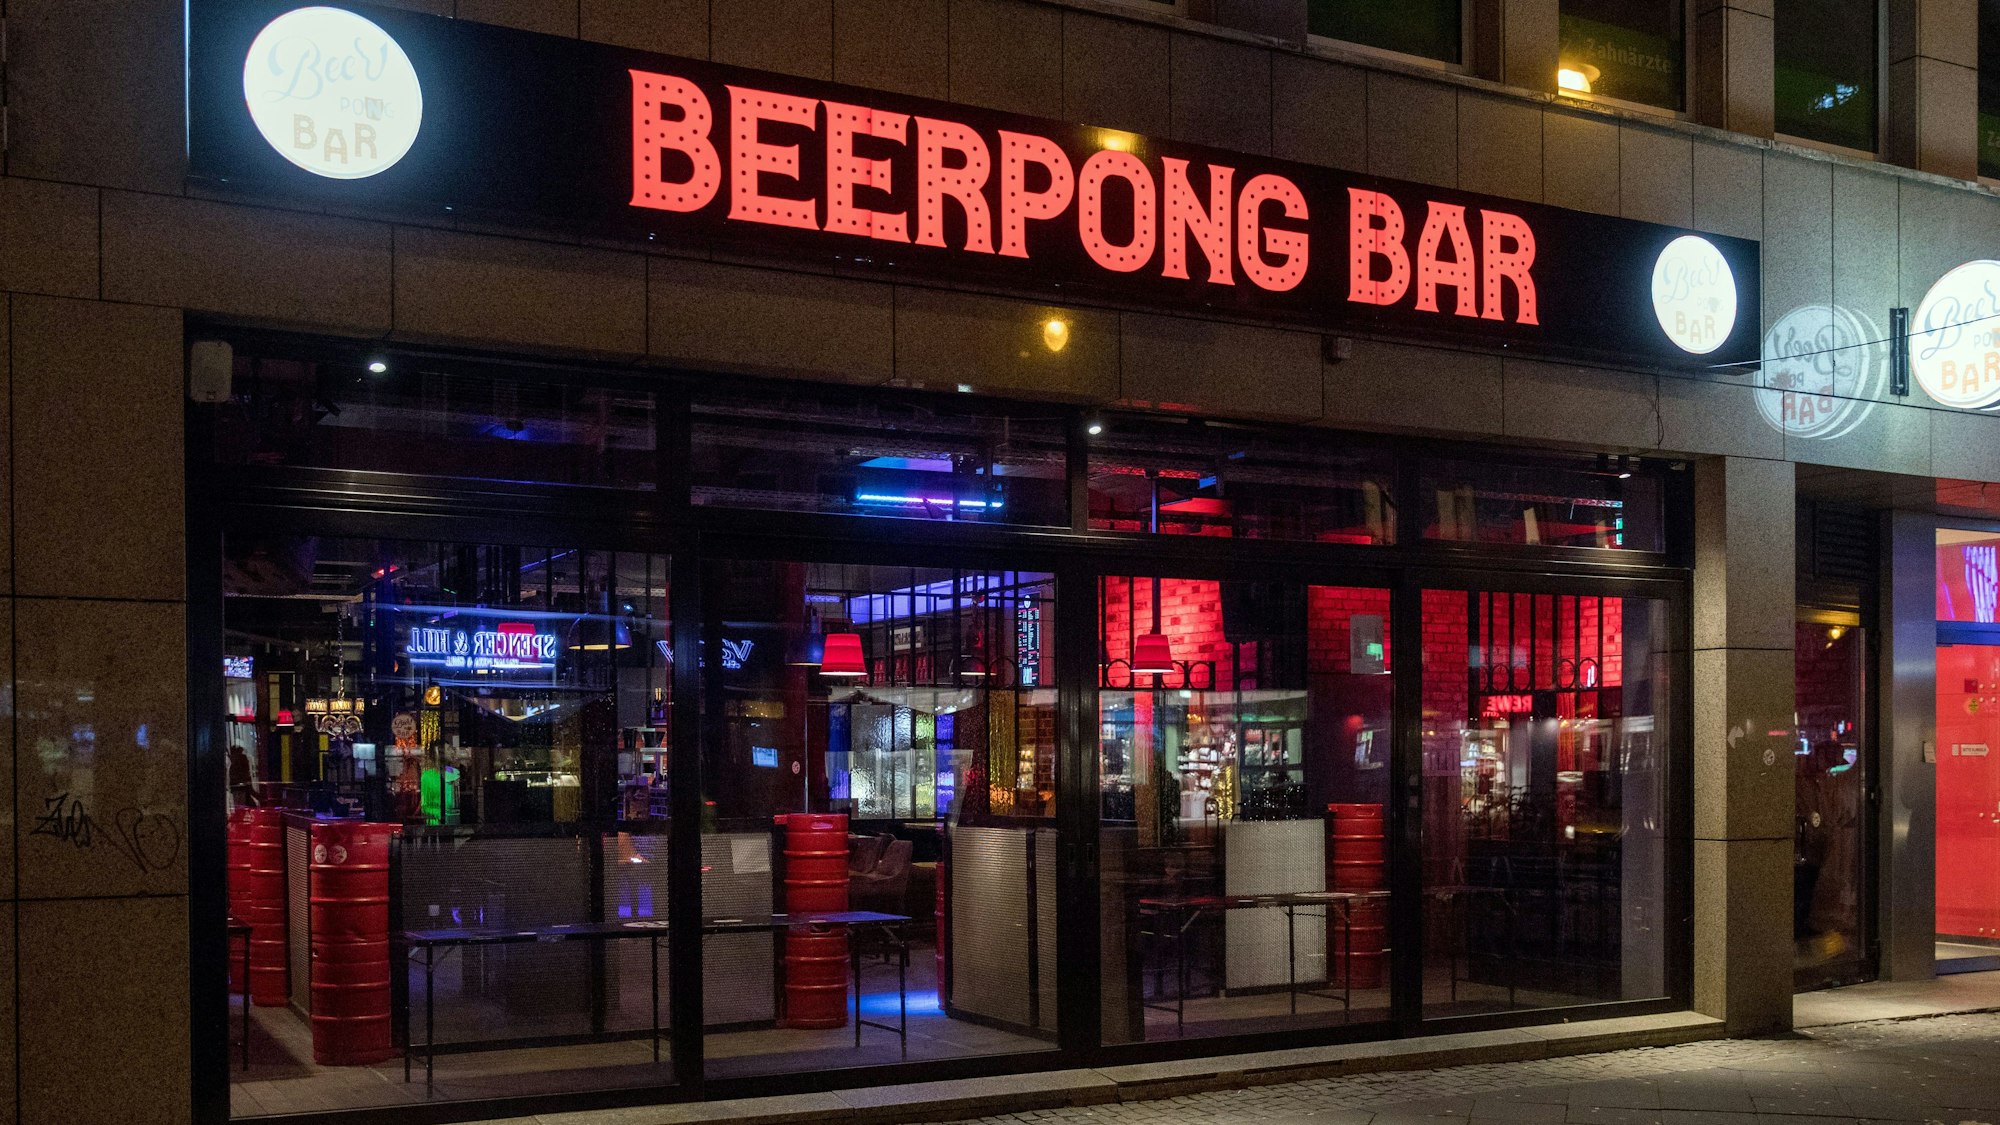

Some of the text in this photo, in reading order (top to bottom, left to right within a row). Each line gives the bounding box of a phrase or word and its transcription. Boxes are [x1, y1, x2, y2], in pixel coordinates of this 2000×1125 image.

[293, 113, 377, 165] BAR
[628, 68, 1539, 325] BEERPONG BAR
[1675, 310, 1716, 344] BAR
[1941, 351, 2000, 394] BAR
